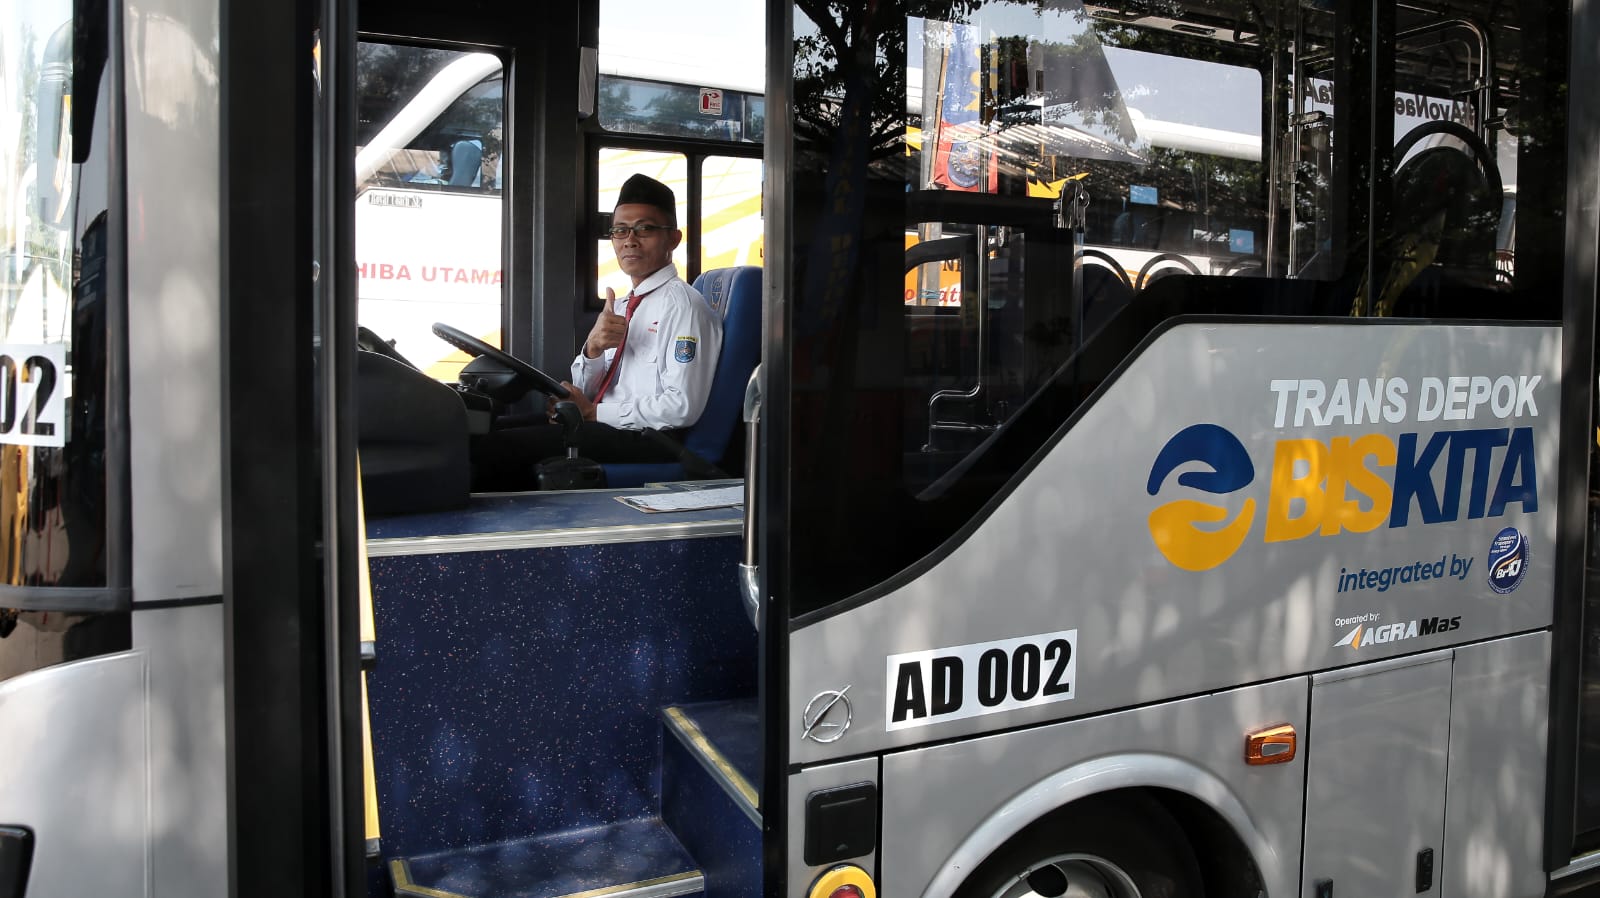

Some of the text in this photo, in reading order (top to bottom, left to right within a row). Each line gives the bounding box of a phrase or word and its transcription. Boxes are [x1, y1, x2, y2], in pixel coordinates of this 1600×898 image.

[421, 265, 503, 285] UTAMA
[1270, 374, 1543, 429] TRANS DEPOK
[1337, 554, 1475, 593] integrated by
[1334, 613, 1368, 628] Operated
[891, 638, 1072, 724] AD 002
